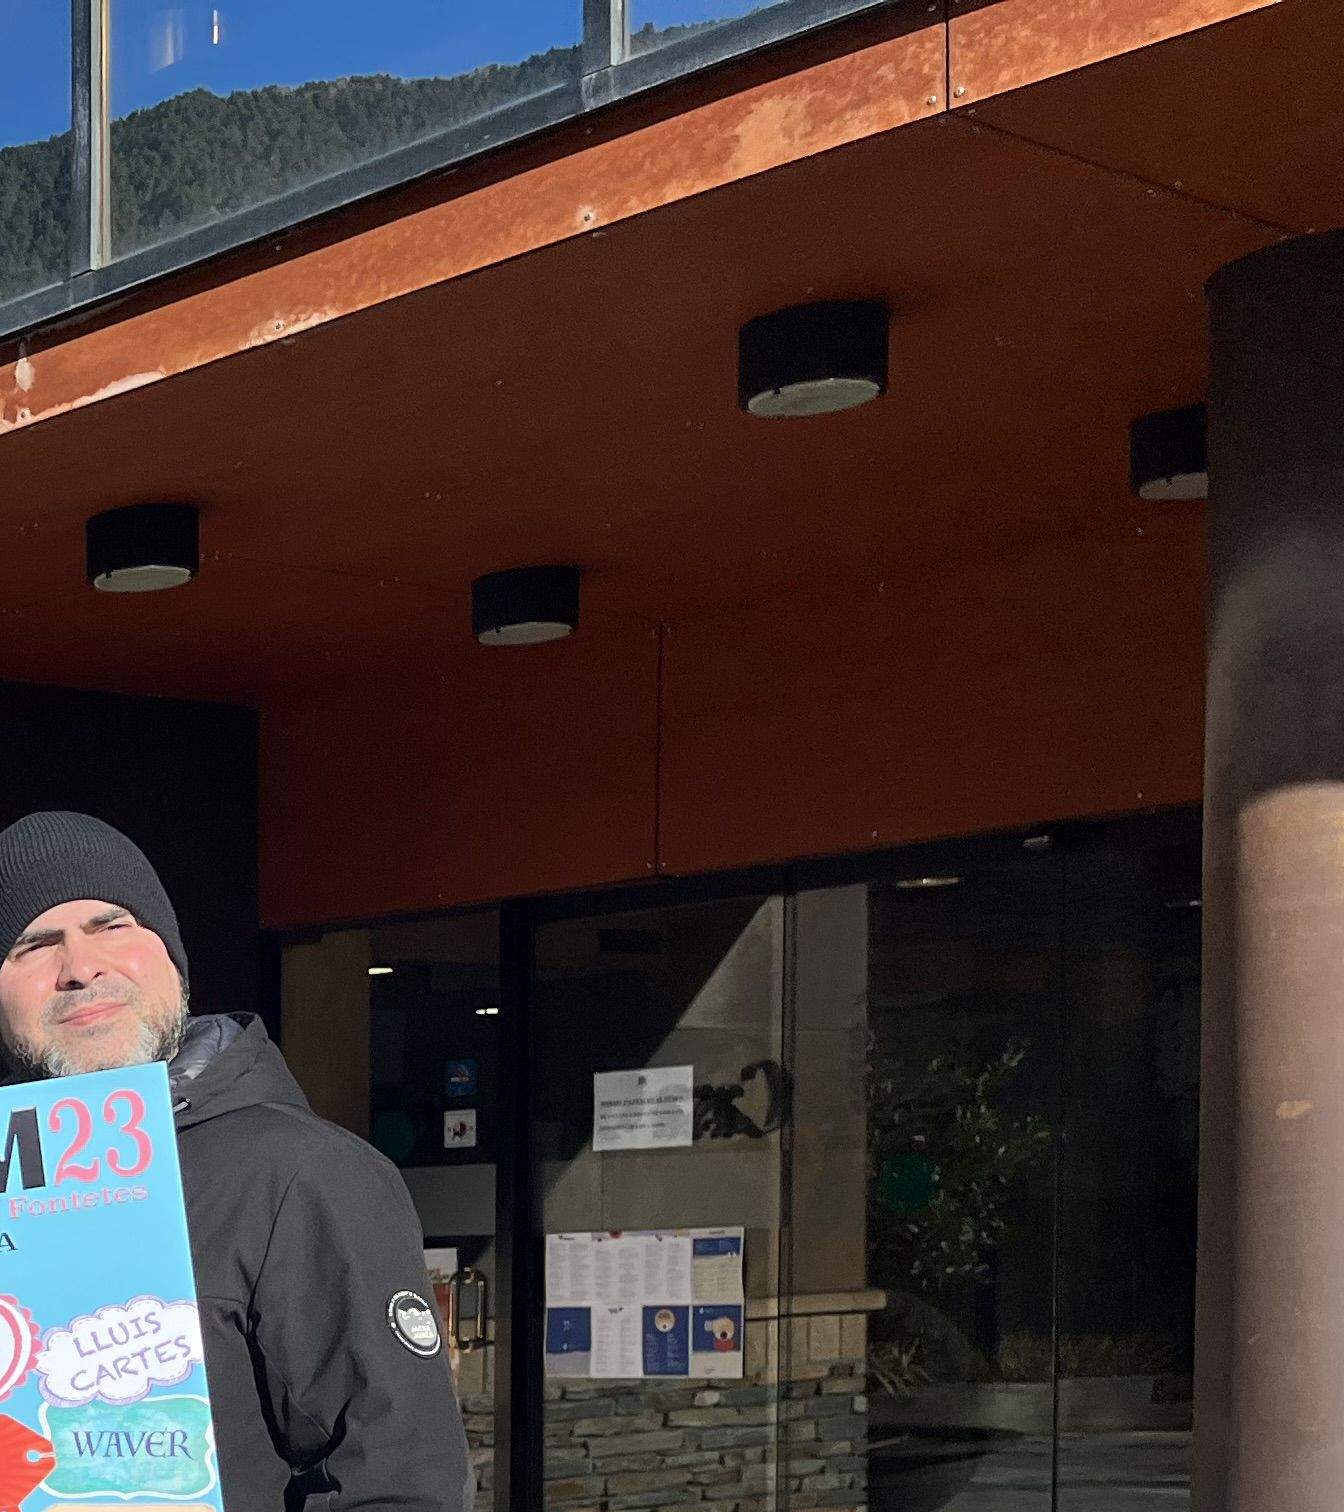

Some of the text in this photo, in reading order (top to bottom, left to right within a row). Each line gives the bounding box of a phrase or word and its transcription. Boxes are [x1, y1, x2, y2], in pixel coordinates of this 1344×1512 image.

[6, 1179, 150, 1221] Fontetes
[73, 1311, 162, 1358] LLUIS
[70, 1334, 192, 1391] CARTES
[72, 1427, 195, 1460] WAVER
